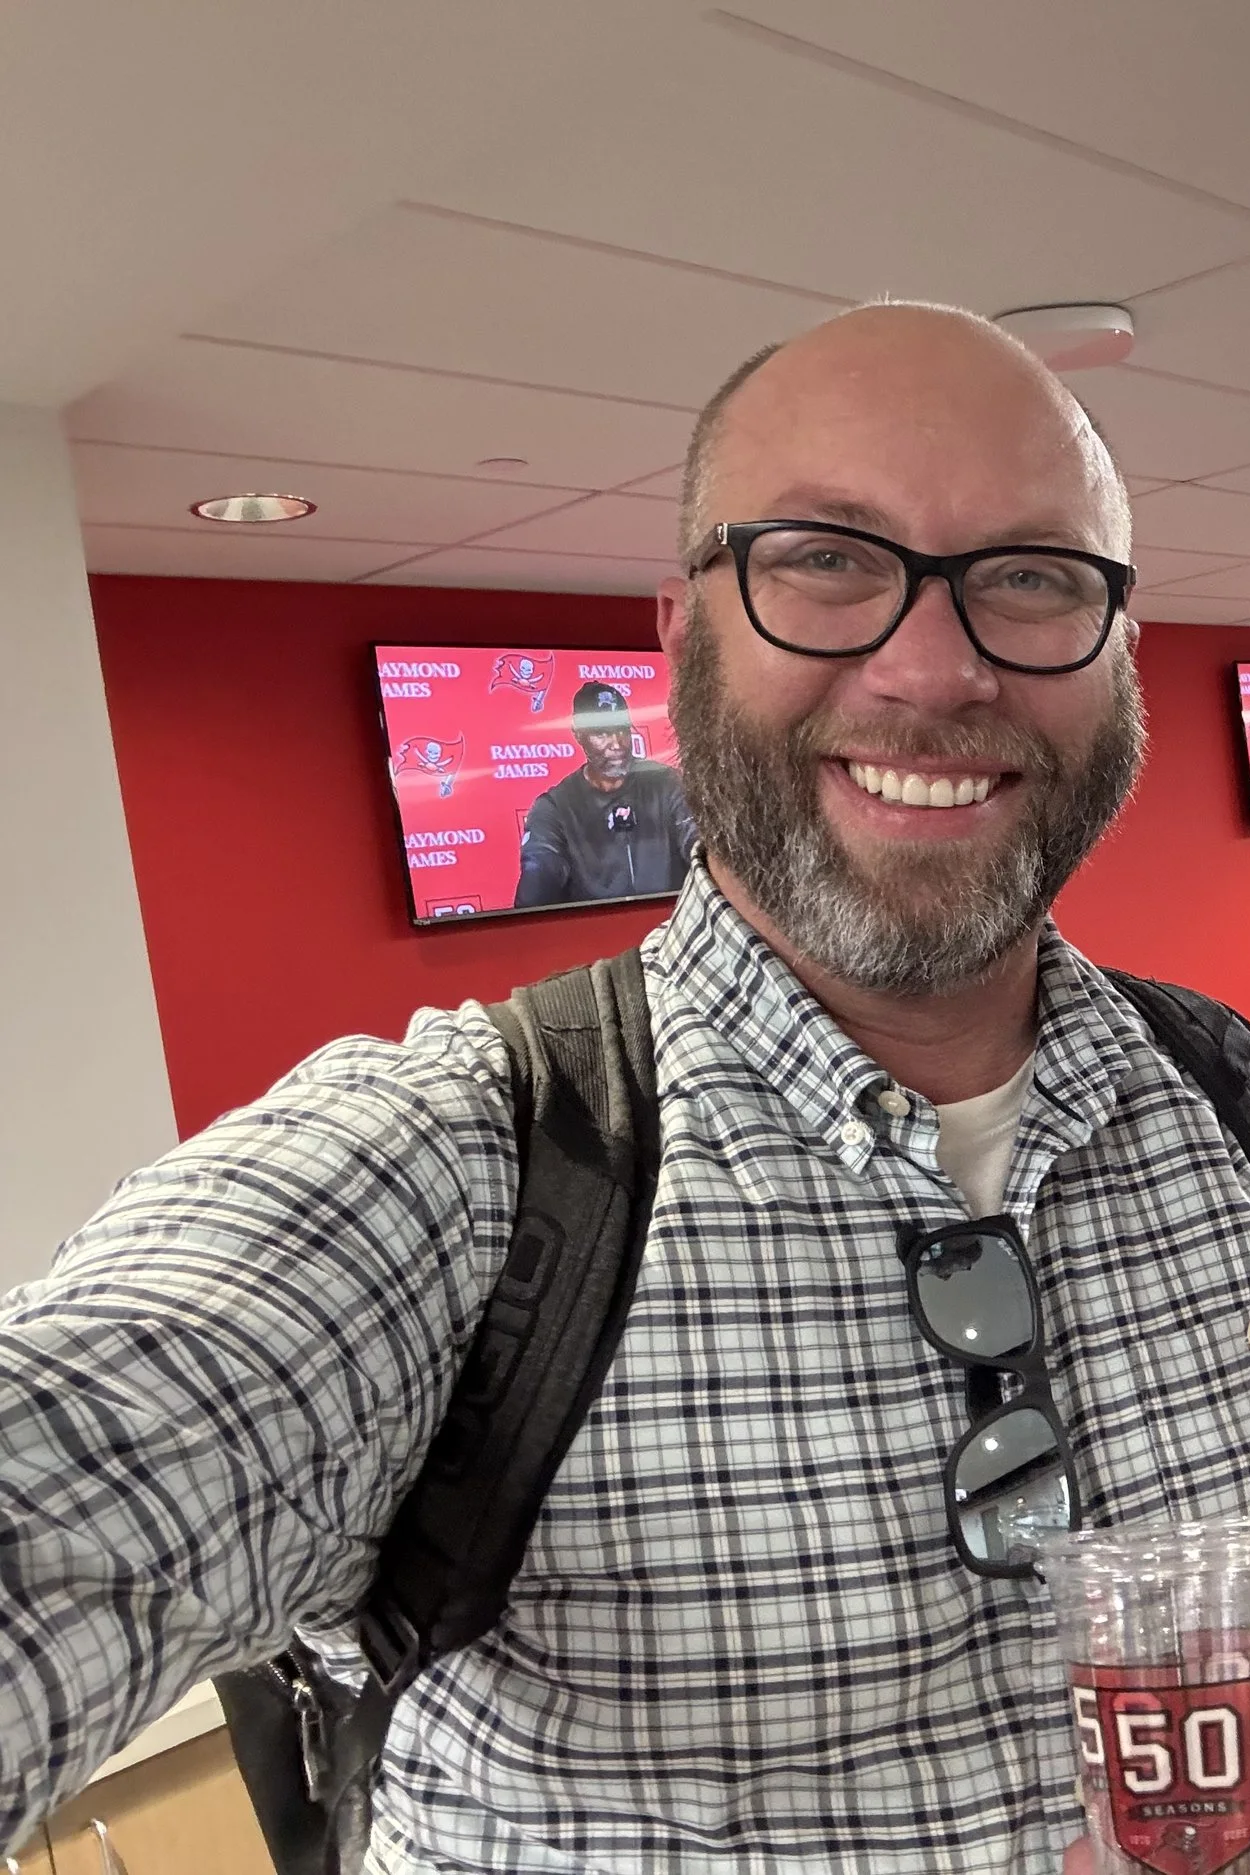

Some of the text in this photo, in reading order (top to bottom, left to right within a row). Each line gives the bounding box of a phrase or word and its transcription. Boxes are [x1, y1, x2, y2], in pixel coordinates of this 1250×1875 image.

[379, 662, 461, 678] AYMOND
[578, 664, 656, 679] RAYMOND
[490, 743, 575, 760] RAYMOND
[494, 763, 549, 779] JAMES
[1116, 1707, 1241, 1794] 50
[1142, 1801, 1228, 1817] SEASONS
